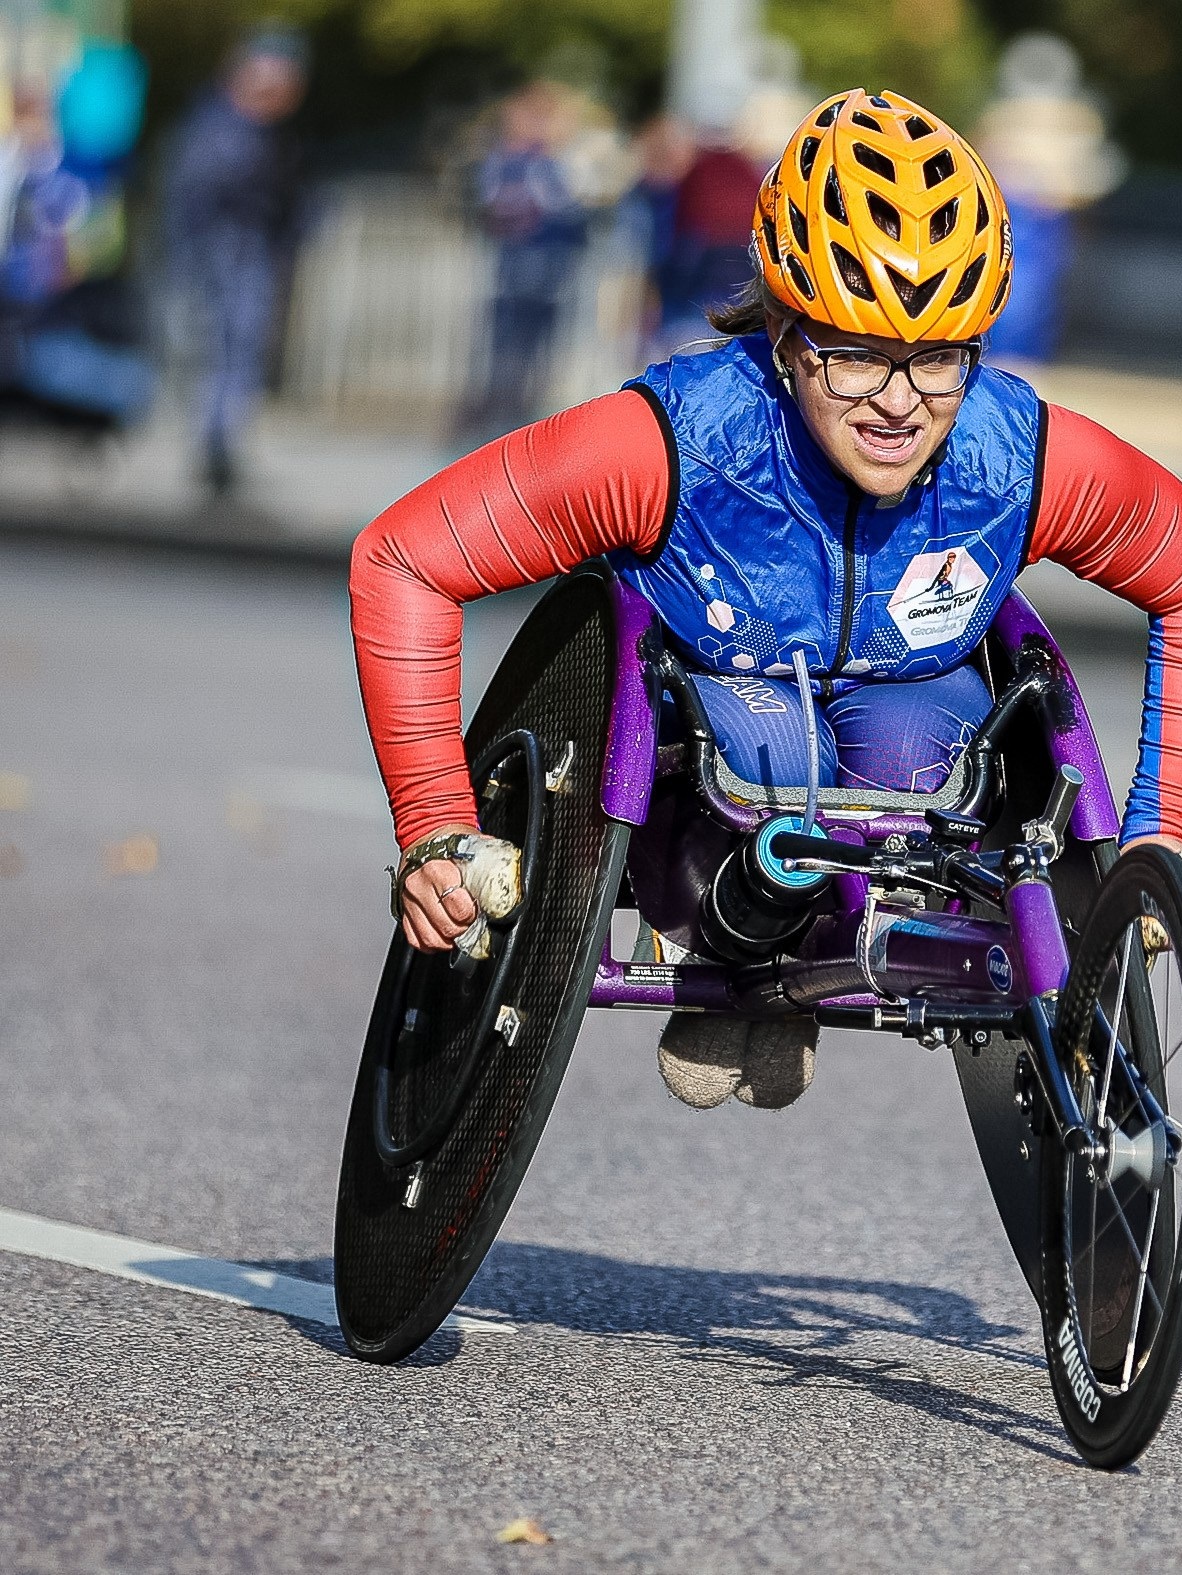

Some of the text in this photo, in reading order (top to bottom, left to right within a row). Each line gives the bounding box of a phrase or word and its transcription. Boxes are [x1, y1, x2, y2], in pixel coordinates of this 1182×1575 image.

[953, 590, 978, 608] TEAM
[949, 822, 979, 833] CATEYE
[1059, 1317, 1101, 1423] CORIMA
